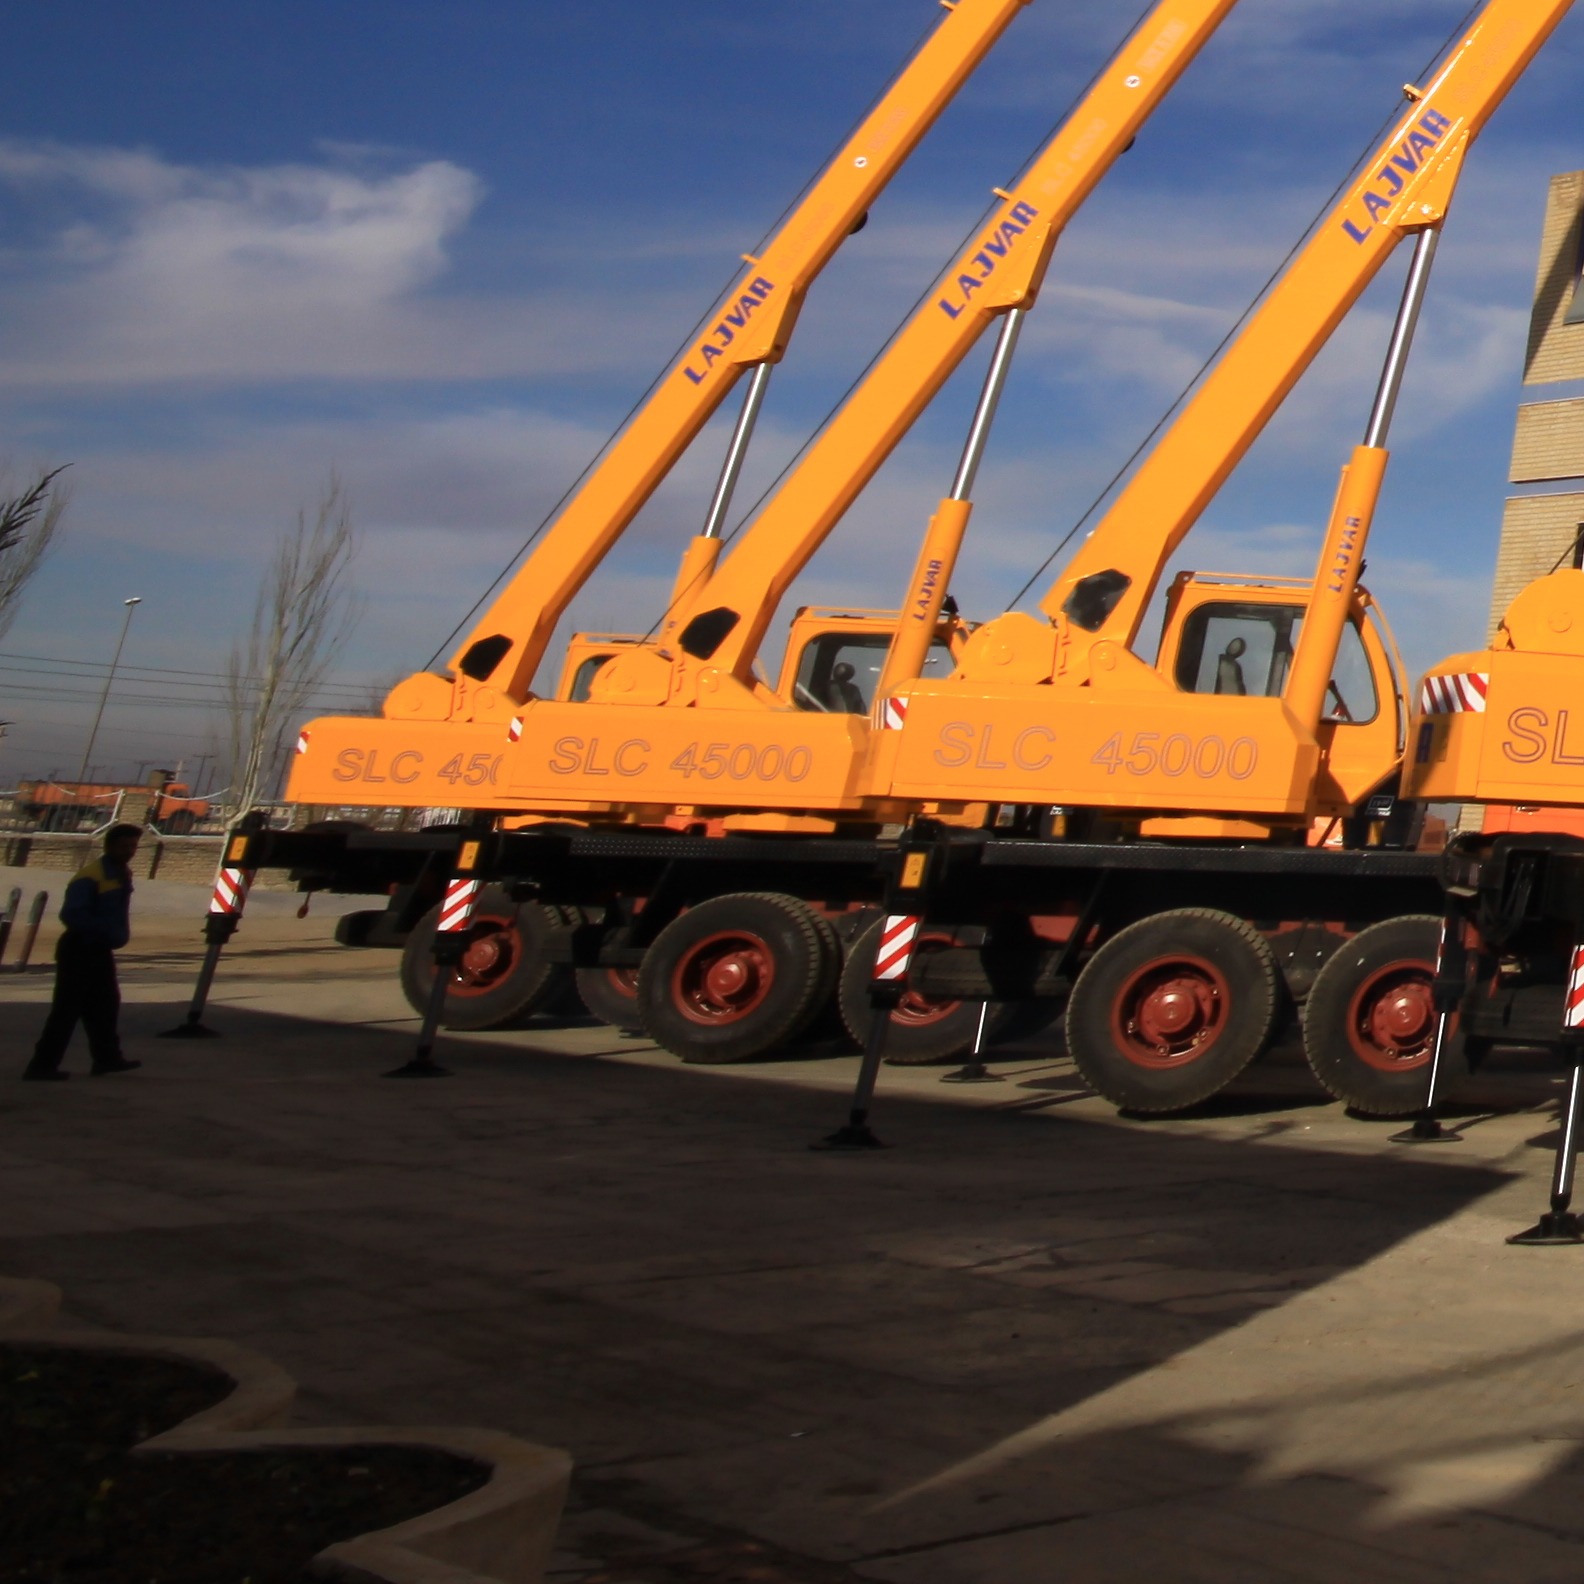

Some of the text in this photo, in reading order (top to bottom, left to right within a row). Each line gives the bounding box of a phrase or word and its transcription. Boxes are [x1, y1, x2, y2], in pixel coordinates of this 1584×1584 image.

[1341, 109, 1451, 245] LAJVAR
[938, 200, 1040, 320] LAJVAR
[683, 276, 775, 386] LAJVAR
[1328, 516, 1361, 593] LAJVAR
[912, 559, 943, 621] LAJVAR
[332, 748, 424, 784] SLC
[548, 736, 813, 782] SLC 45000
[933, 721, 1258, 780] SLC 45000
